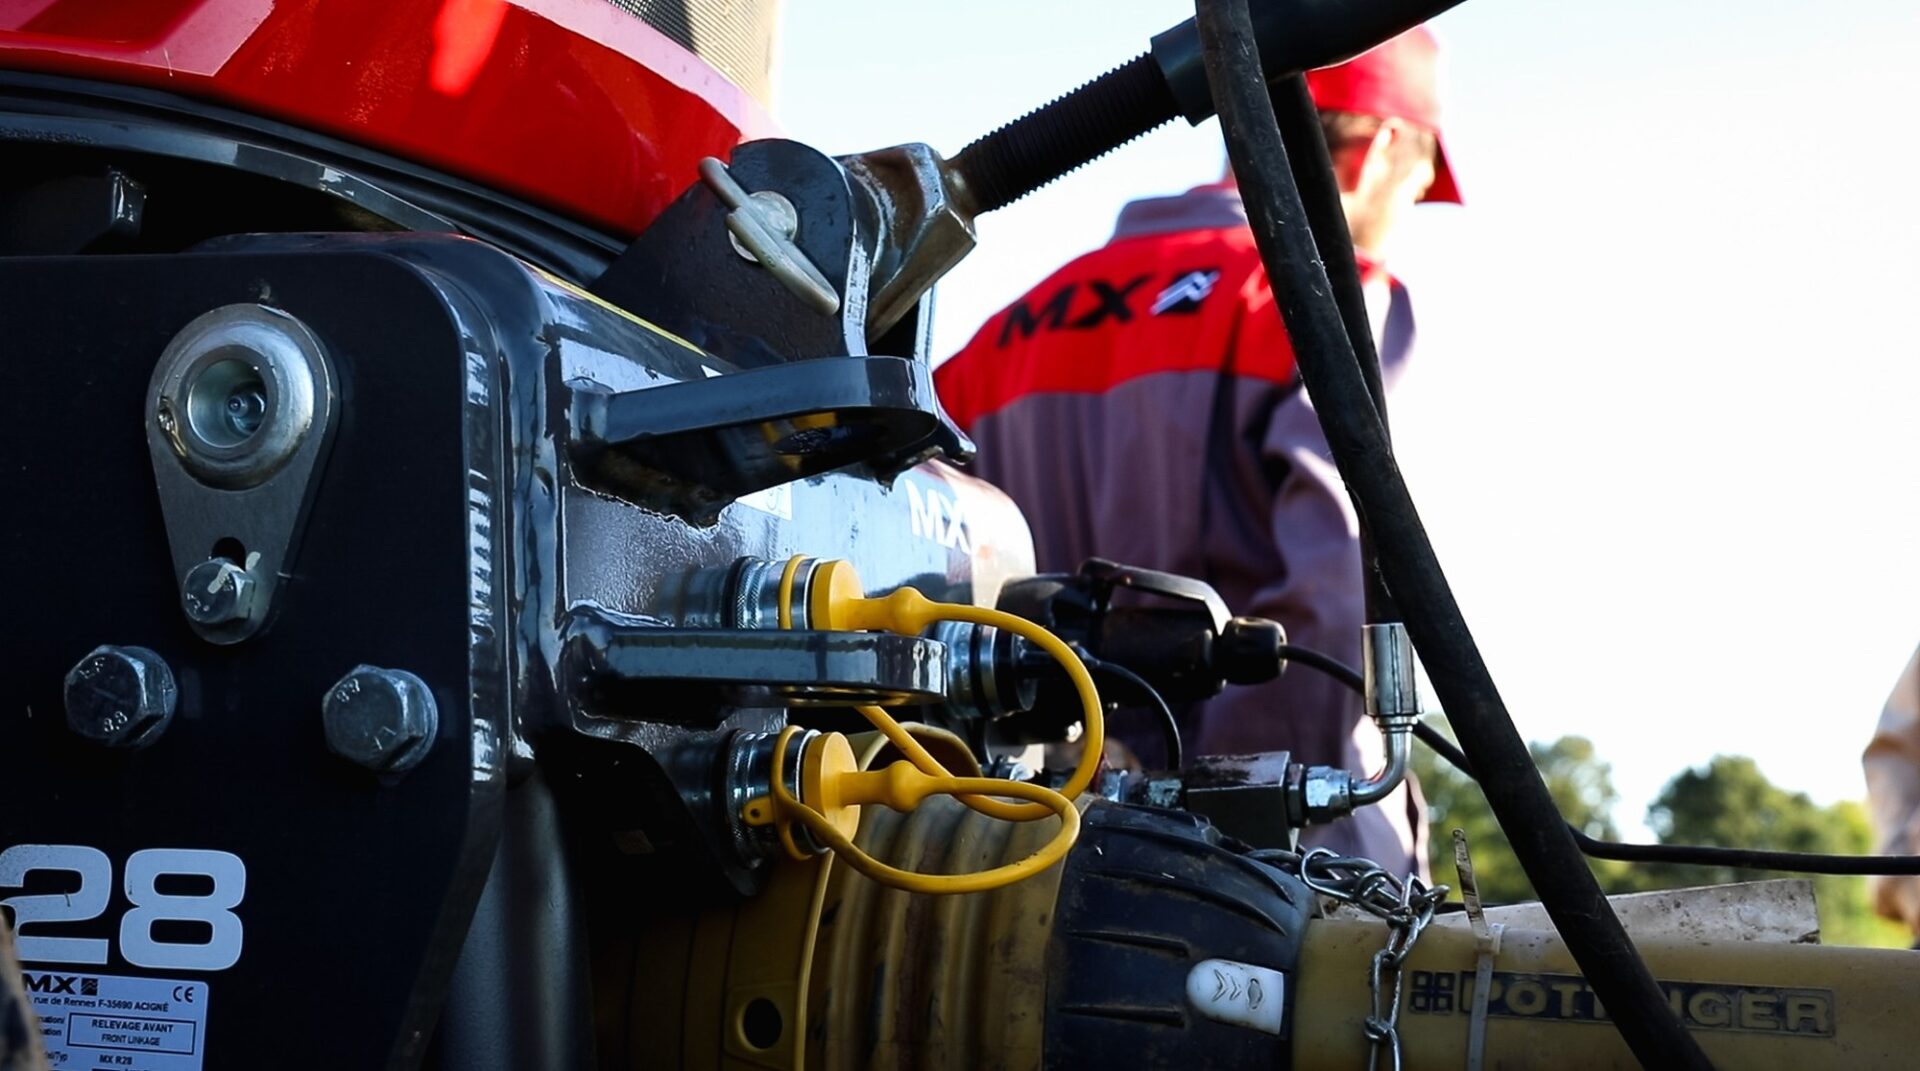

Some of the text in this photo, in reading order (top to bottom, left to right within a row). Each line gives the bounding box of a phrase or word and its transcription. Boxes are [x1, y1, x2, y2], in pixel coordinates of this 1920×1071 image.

[998, 273, 1155, 347] MX
[904, 479, 972, 556] MX
[0, 844, 246, 971] 28
[22, 973, 78, 995] MX
[50, 997, 62, 1005] de
[64, 998, 96, 1008] Rennes
[1462, 976, 1829, 1032] PÖTGER
[92, 1019, 174, 1033] RELEVAGE AVANT
[101, 1034, 160, 1046] FRONT LINKAGE
[99, 1054, 114, 1064] MX
